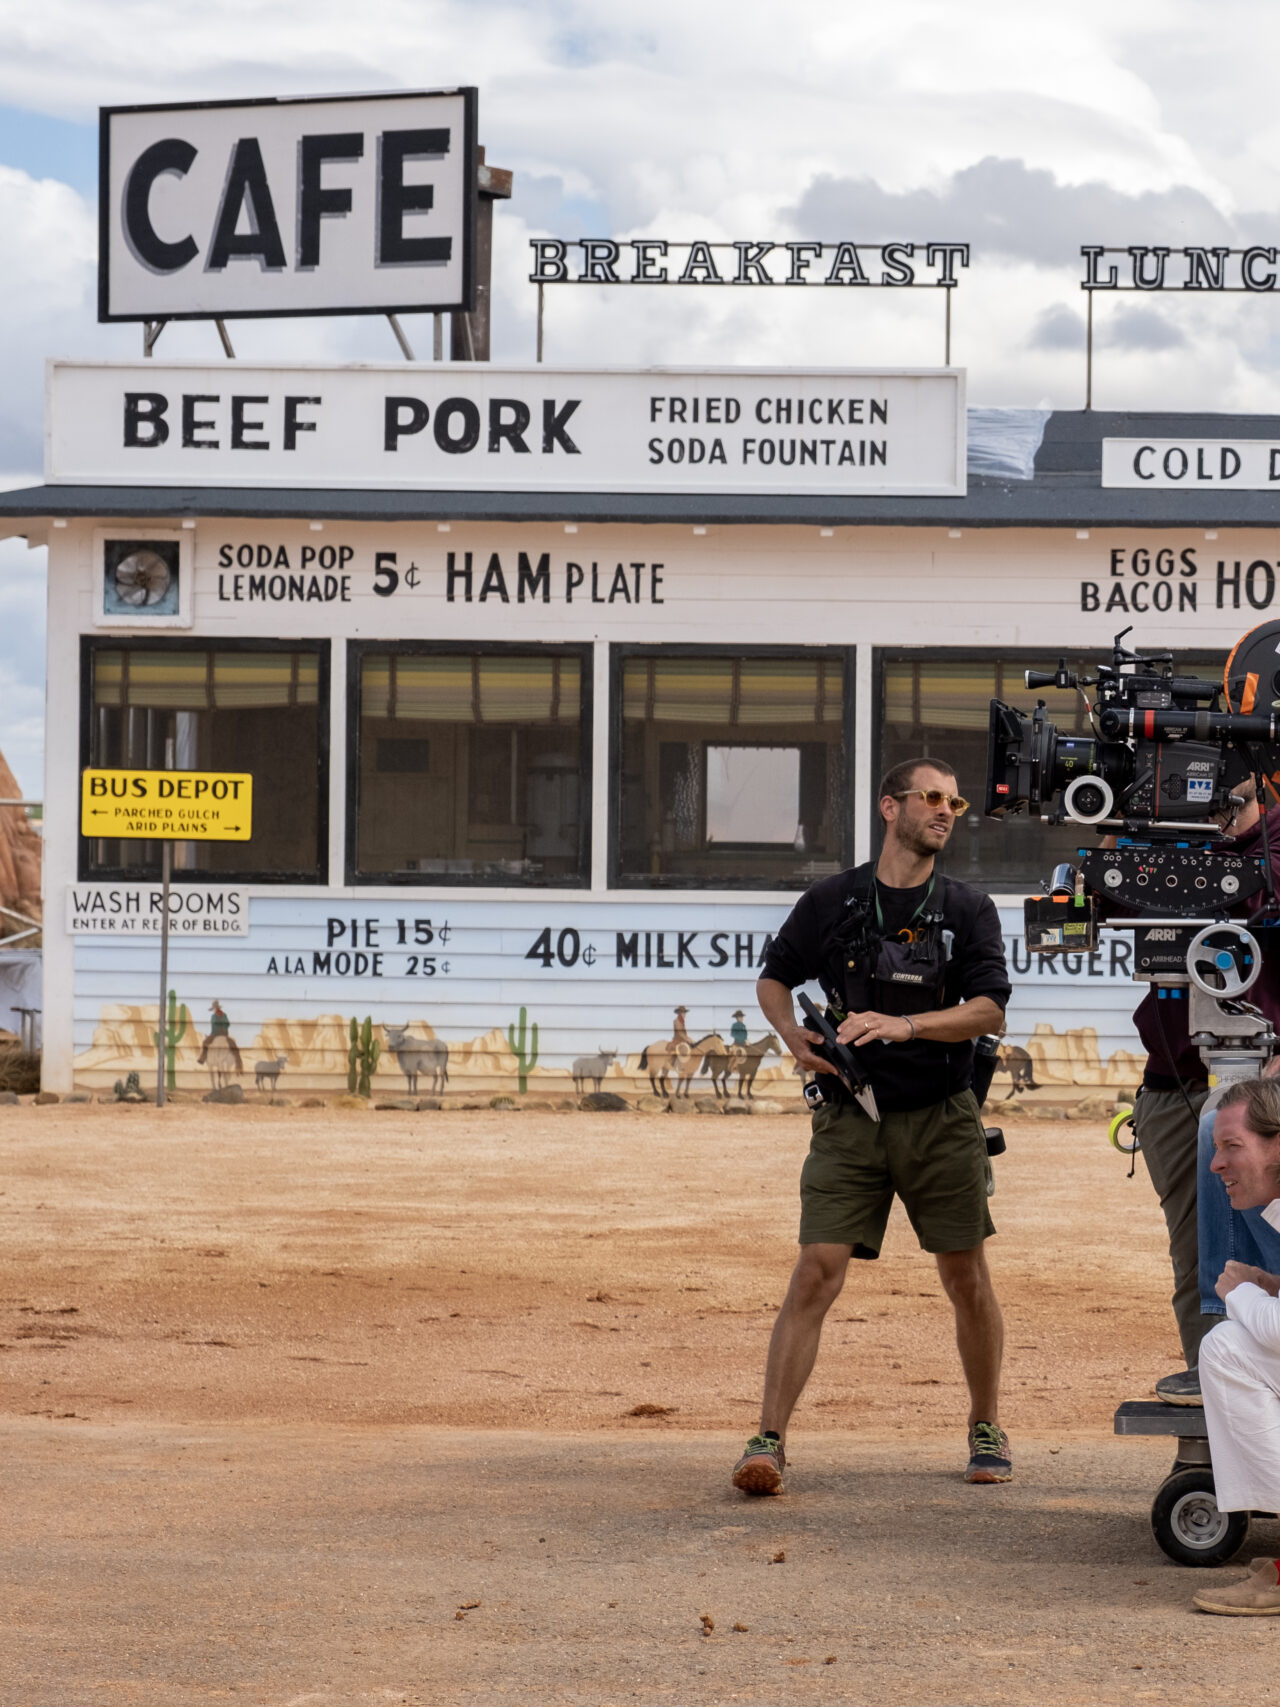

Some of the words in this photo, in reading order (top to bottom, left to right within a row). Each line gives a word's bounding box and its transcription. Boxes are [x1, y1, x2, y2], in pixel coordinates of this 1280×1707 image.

[122, 128, 452, 274] CAFE
[529, 238, 969, 287] BREAKFAST
[123, 392, 322, 451] BEEF
[383, 396, 582, 455] PORK
[650, 397, 741, 423] FRIED
[755, 398, 888, 424] CHICKEN
[648, 437, 727, 465] SODA
[742, 438, 887, 466] FOUNTAIN
[1133, 446, 1242, 480] COLD
[218, 544, 290, 569] SODA
[301, 545, 354, 570] POP
[1110, 548, 1197, 577] EGGS
[219, 574, 352, 602] LEMONADE
[373, 552, 421, 596] 5¢
[446, 552, 551, 604] HAM
[565, 562, 664, 604] PLATE
[1081, 581, 1197, 613] BACON
[90, 777, 147, 797] BUS
[158, 779, 244, 800] DEPOT
[1189, 780, 1211, 790] RVZ
[115, 808, 172, 819] PARCHED
[179, 809, 220, 820] GULCH
[126, 822, 157, 831] ARID
[163, 823, 207, 833] PLAINS
[73, 891, 140, 913] WASH
[150, 892, 240, 915] ROOMS
[73, 918, 116, 929] ENTER
[121, 918, 136, 929] AT
[142, 919, 177, 930] RER
[182, 920, 198, 931] OF
[327, 918, 380, 948] PIE
[396, 919, 452, 946] 15¢
[1144, 928, 1176, 941] ARRI
[525, 927, 597, 968] 40¢
[616, 932, 699, 968] MILK
[708, 933, 772, 968] SHA
[1003, 938, 1132, 977] URGER
[267, 956, 278, 975] A
[284, 955, 306, 975] LA
[313, 951, 383, 977] MODE
[405, 957, 451, 976] 25¢
